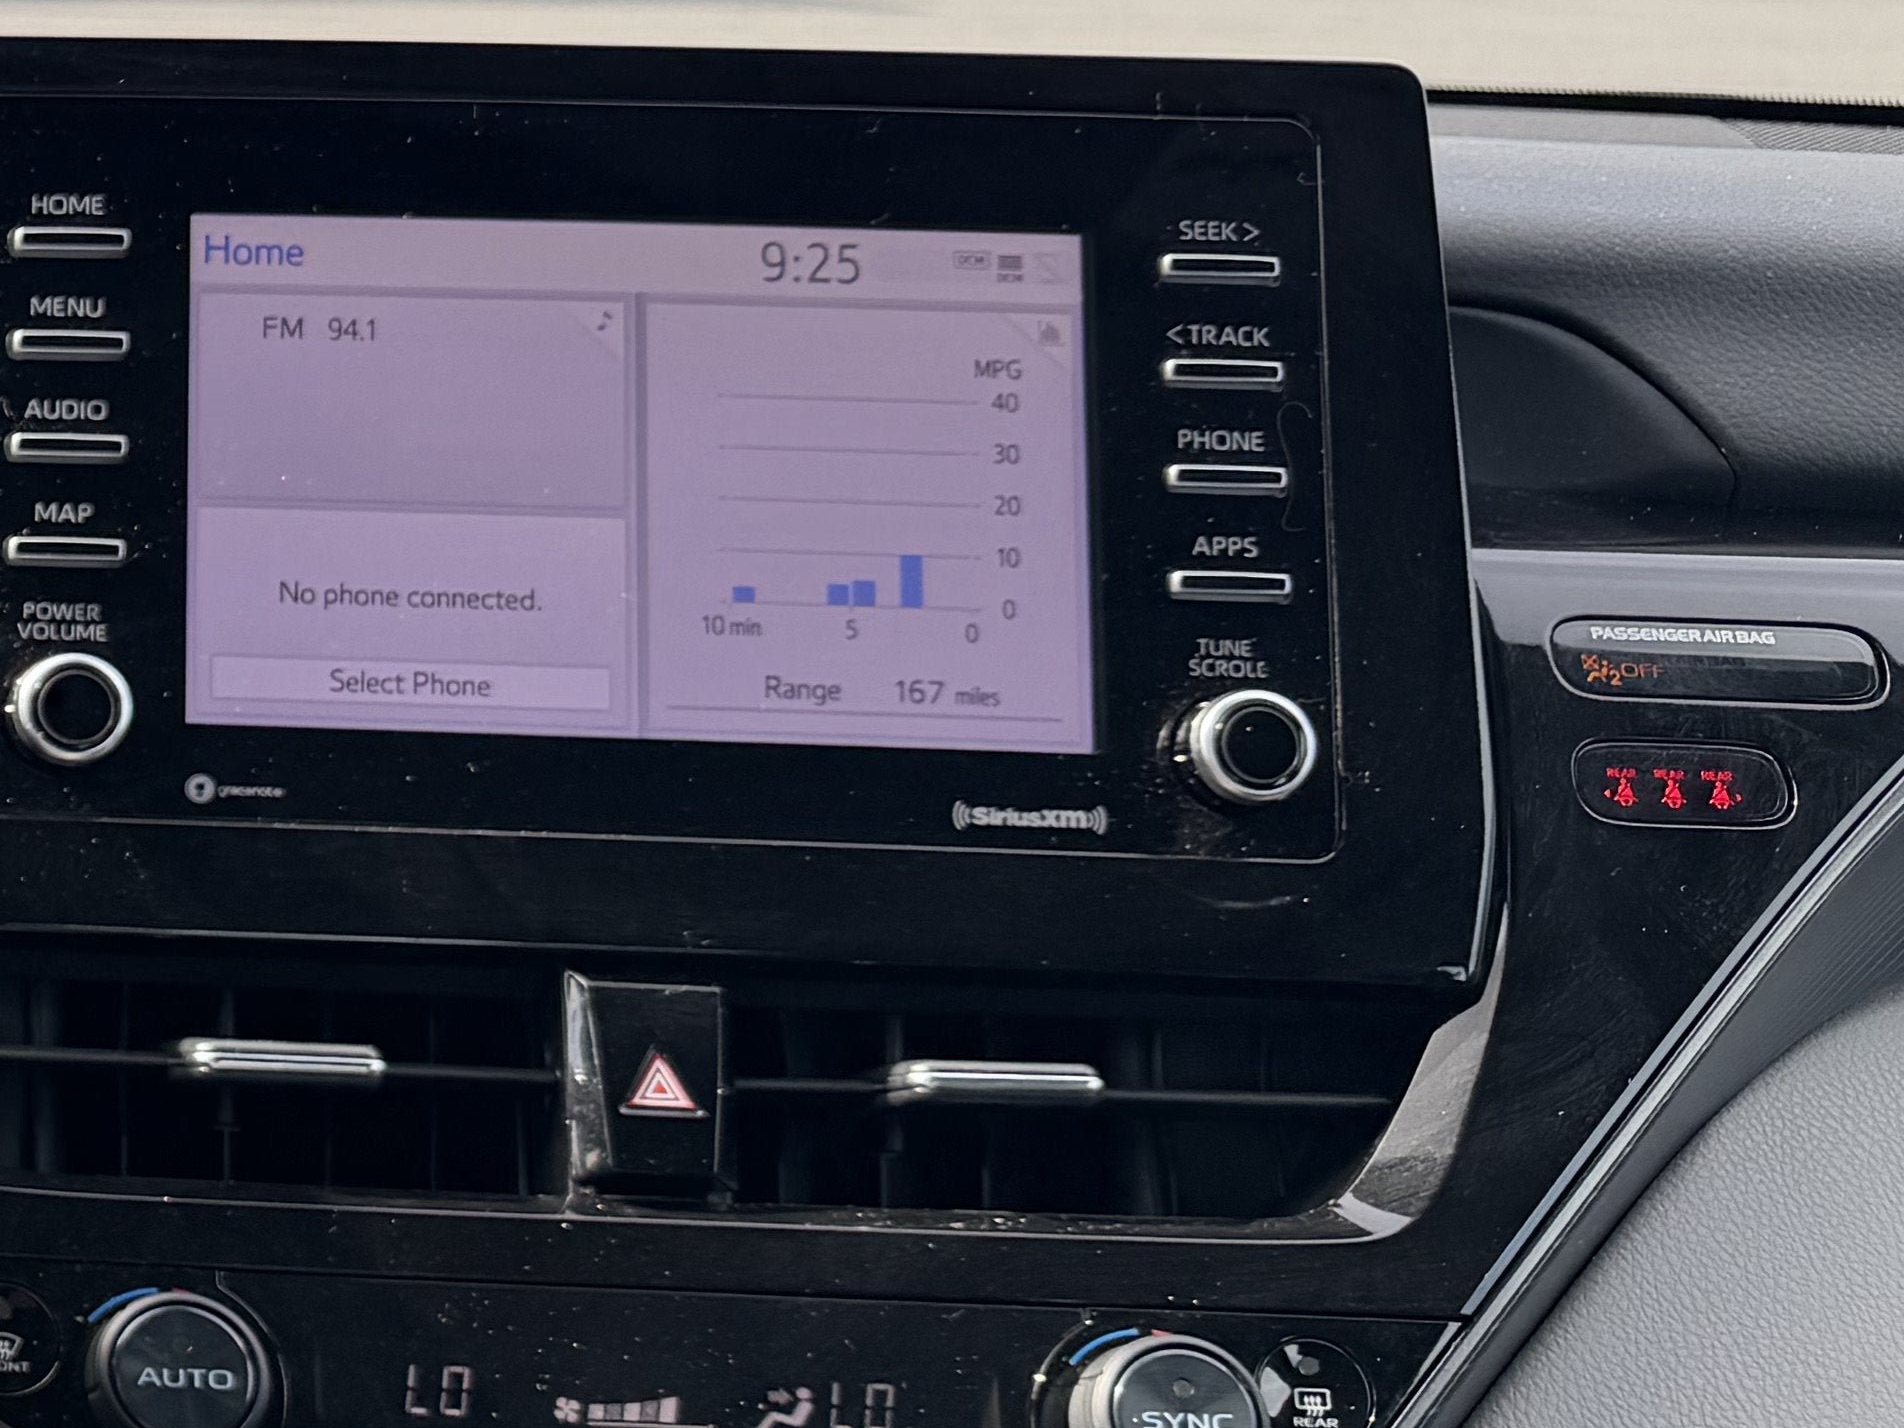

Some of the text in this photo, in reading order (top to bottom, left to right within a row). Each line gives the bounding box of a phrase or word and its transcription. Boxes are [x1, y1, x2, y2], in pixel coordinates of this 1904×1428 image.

[30, 194, 106, 216] HOME
[203, 234, 306, 267] Home
[760, 240, 862, 286] 9:25
[30, 296, 106, 318] MENU
[262, 316, 377, 342] FM 94.1
[974, 359, 1023, 381] MPG
[23, 397, 109, 422] AUDIO
[991, 393, 1020, 414] 40
[1177, 428, 1266, 453] PHONE
[993, 444, 1021, 466] 30
[33, 501, 95, 525] MAP
[994, 495, 1022, 517] 20
[996, 547, 1022, 569] 10
[1191, 536, 1259, 558] APPS
[278, 581, 544, 612] No phone connected.
[21, 601, 102, 623] POWER
[1002, 599, 1018, 620] 0
[16, 621, 108, 642] VOLUME
[701, 614, 763, 637] 10 min
[845, 620, 859, 641] 5
[964, 623, 980, 644] 0
[1589, 625, 1701, 644] PASSENGER
[1195, 638, 1254, 659] TUNE
[1188, 658, 1269, 680] SCROLL
[1621, 662, 1665, 679] OFF
[328, 668, 492, 698] Select Phone
[764, 675, 1002, 709] Range 167 miles
[136, 1366, 235, 1391] AUTO
[1292, 1416, 1340, 1428] REAR
